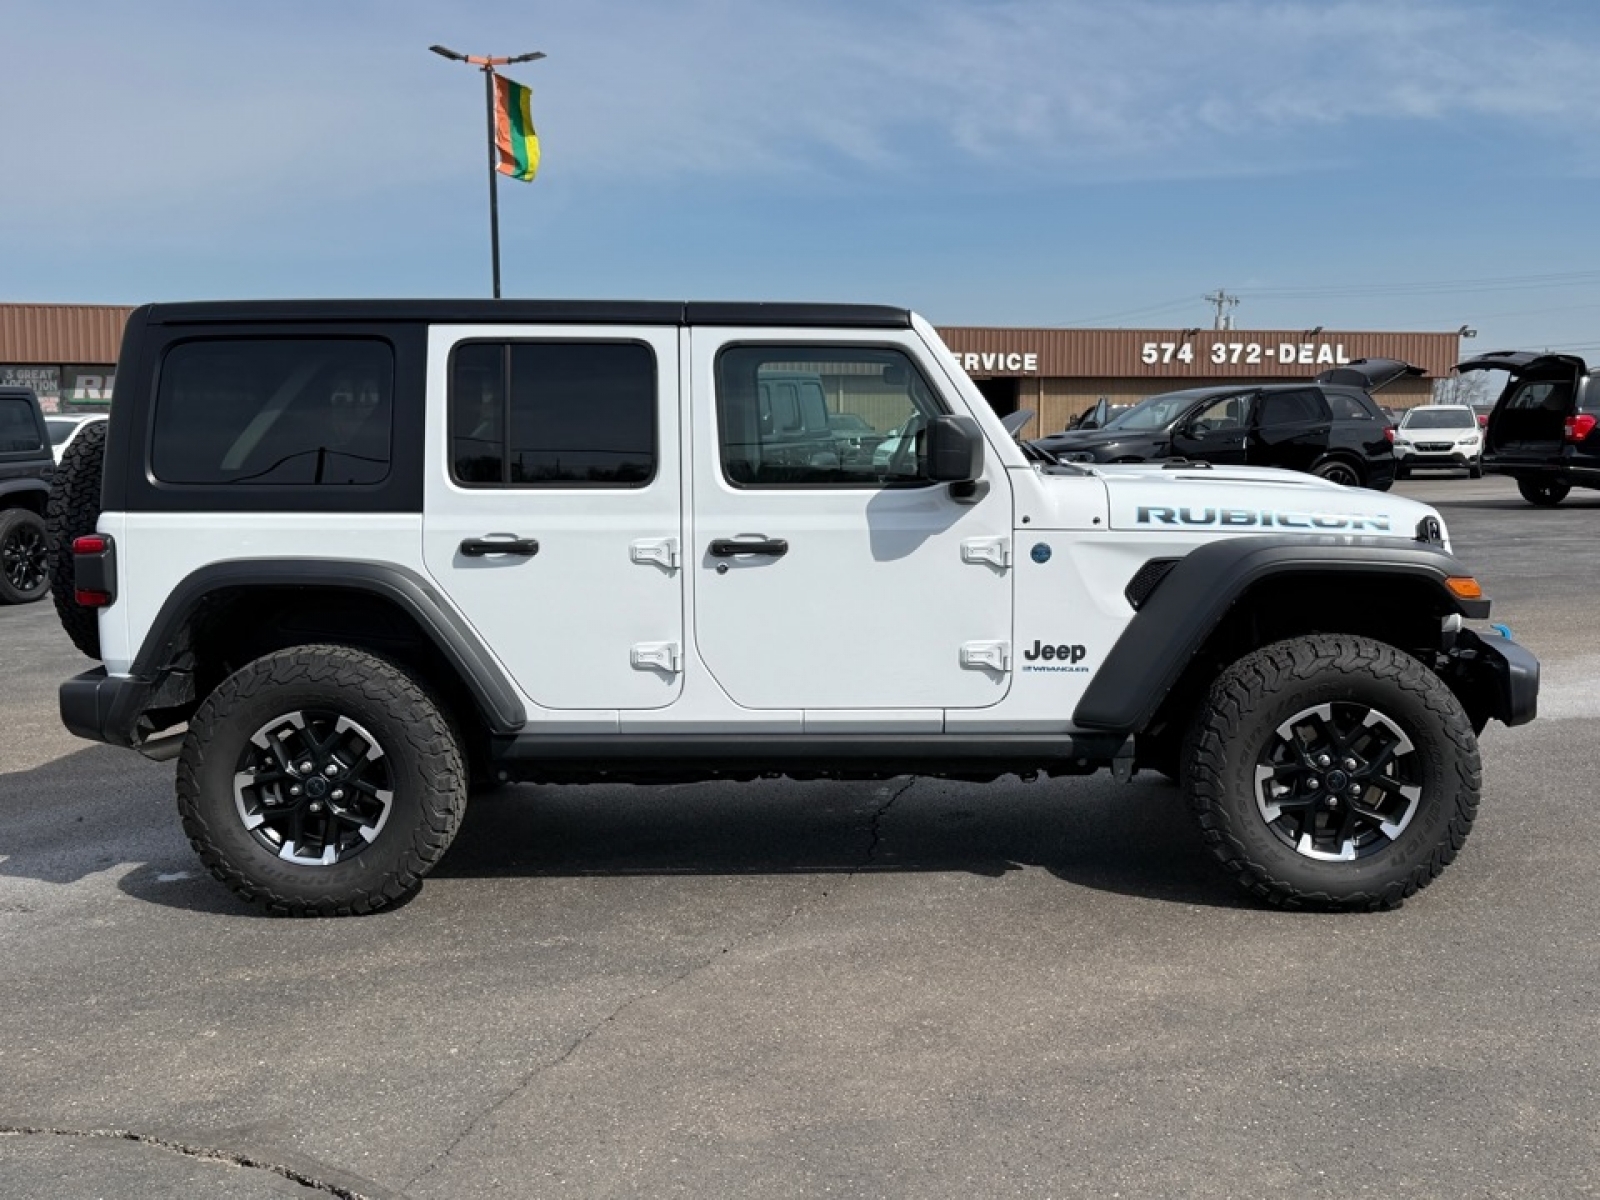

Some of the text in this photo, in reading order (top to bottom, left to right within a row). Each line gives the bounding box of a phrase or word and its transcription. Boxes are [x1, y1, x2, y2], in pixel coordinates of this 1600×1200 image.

[1141, 342, 1350, 364] 574 372-DEAL
[6, 369, 54, 379] 3 GREAT
[1136, 505, 1390, 531] RUBICON
[1024, 639, 1086, 664] Jeep
